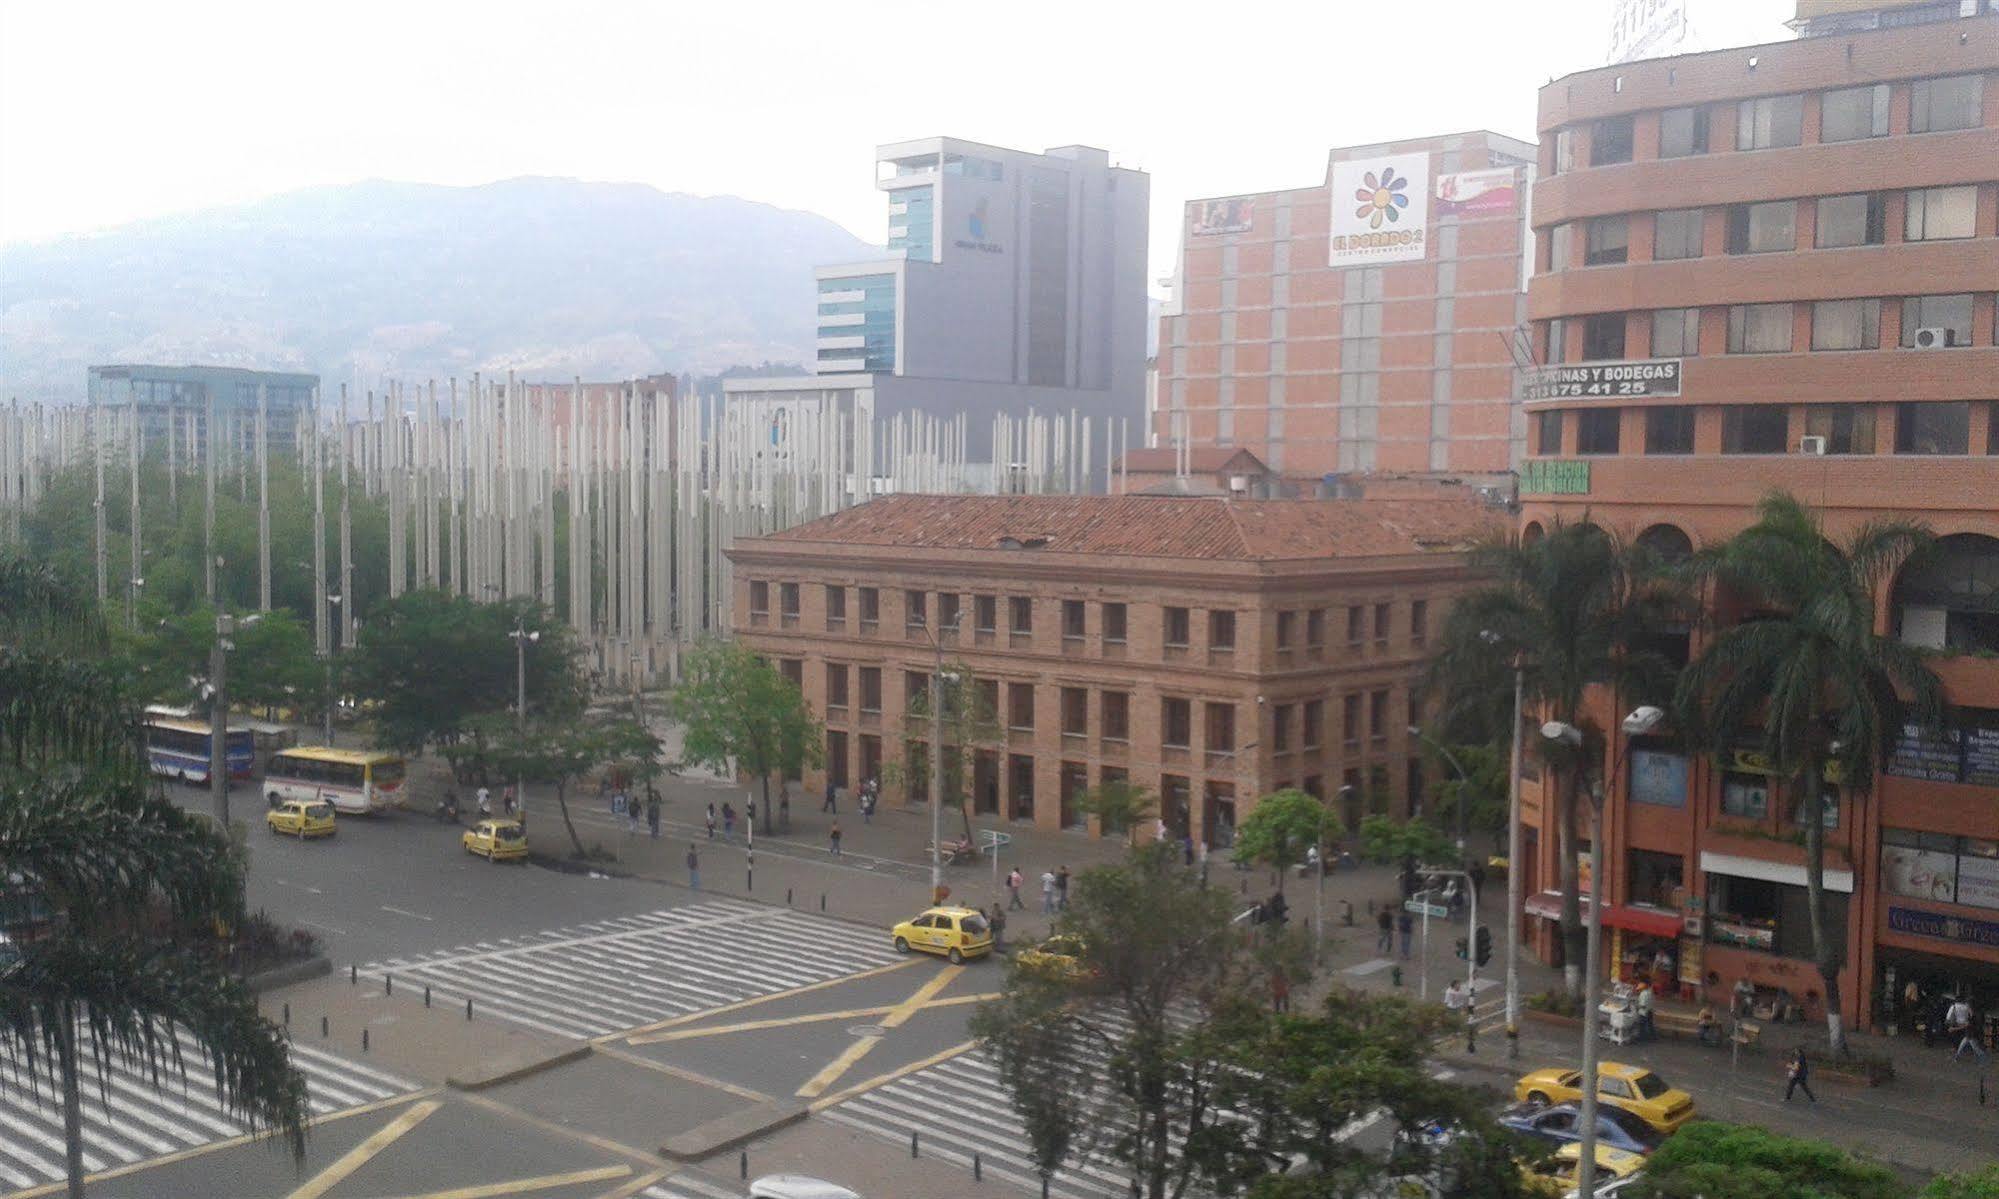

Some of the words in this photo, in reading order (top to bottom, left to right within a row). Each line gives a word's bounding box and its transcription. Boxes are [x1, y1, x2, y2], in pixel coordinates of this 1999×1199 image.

[1348, 229, 1412, 250] DORADO
[1414, 229, 1424, 241] 2
[1591, 368, 1602, 382] Y
[1604, 364, 1674, 381] BODEGAS
[1587, 383, 1611, 395] 41
[1618, 381, 1646, 394] 25
